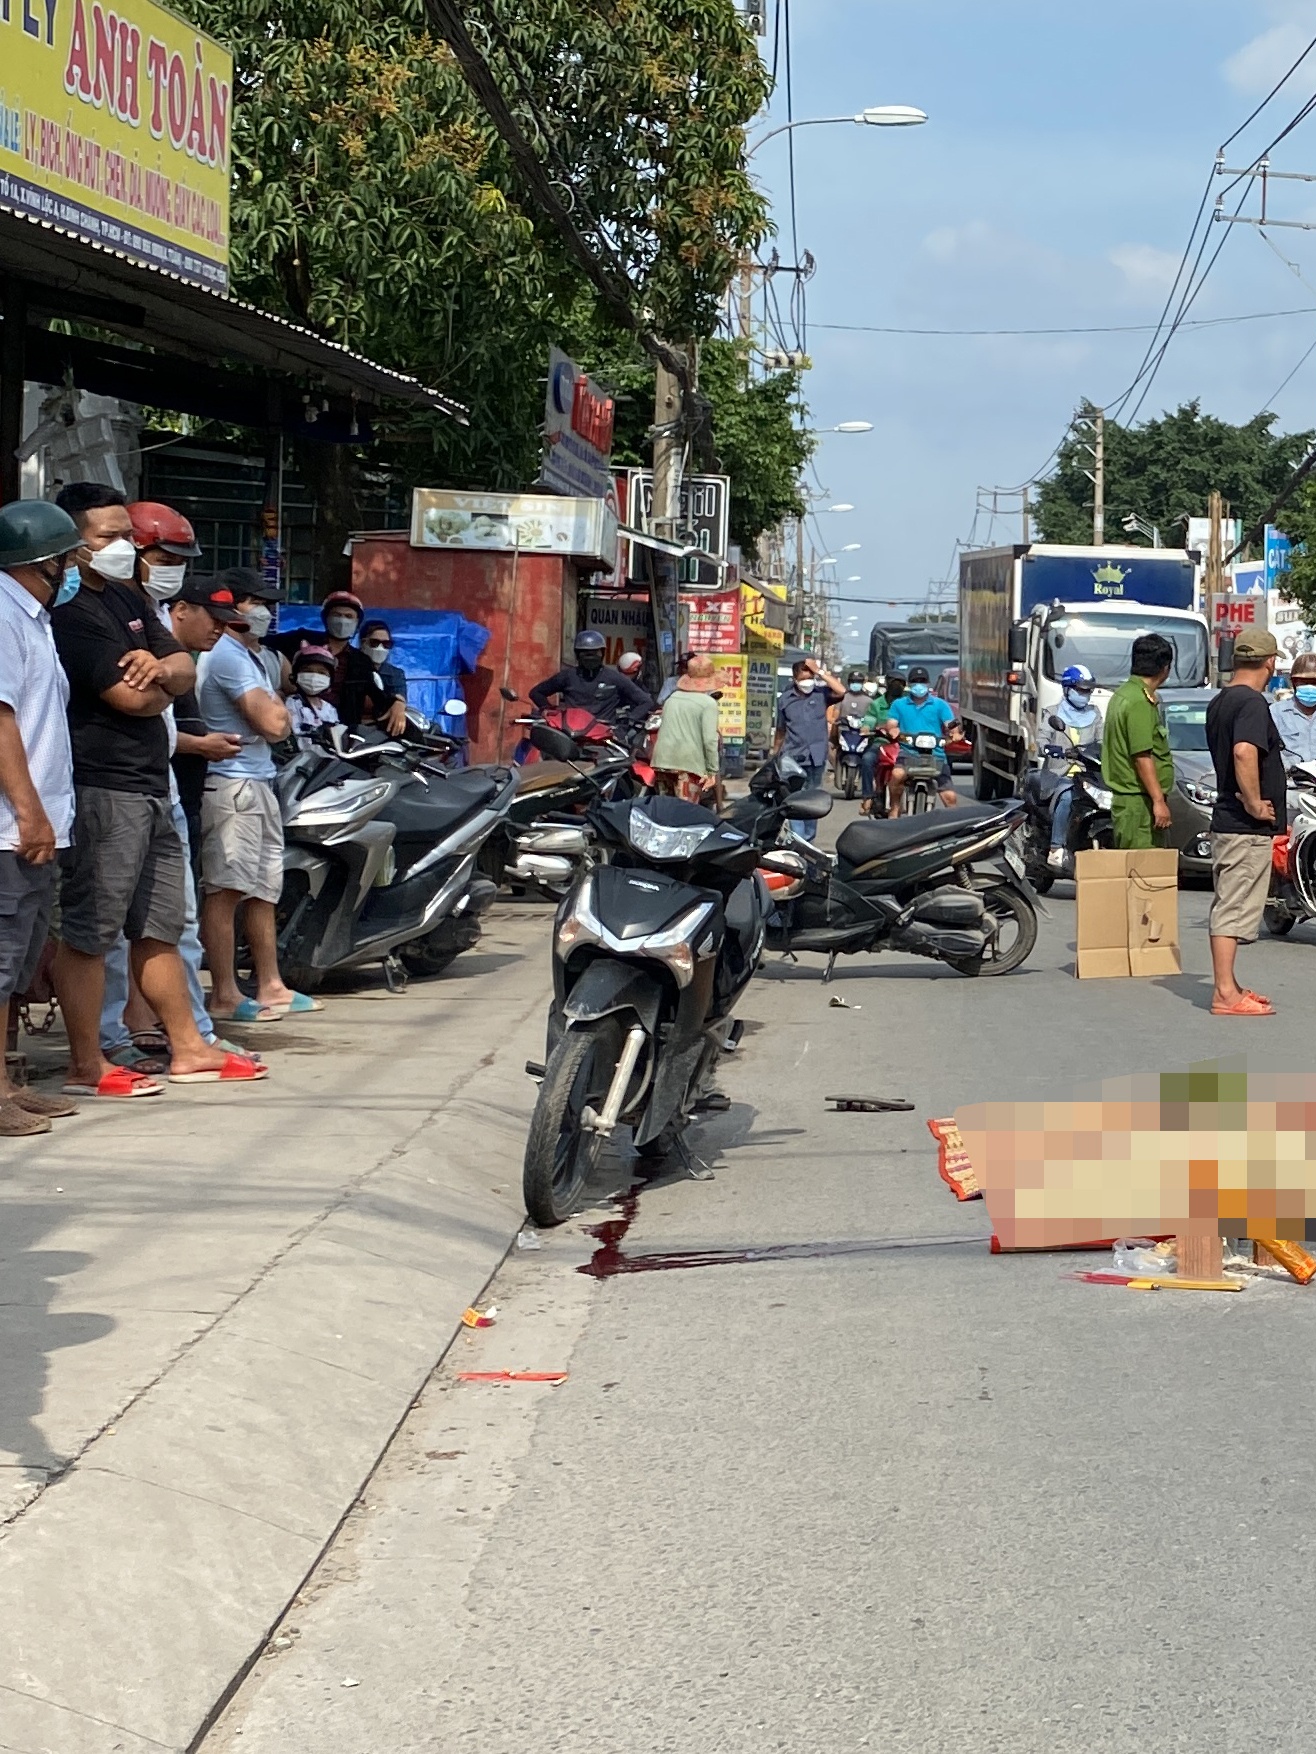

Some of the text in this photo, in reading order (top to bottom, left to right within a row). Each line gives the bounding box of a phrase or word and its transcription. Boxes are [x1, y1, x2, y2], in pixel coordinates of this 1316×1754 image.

[65, 0, 140, 126] ANH
[148, 40, 228, 172] TOÀN
[1093, 582, 1124, 598] Royal
